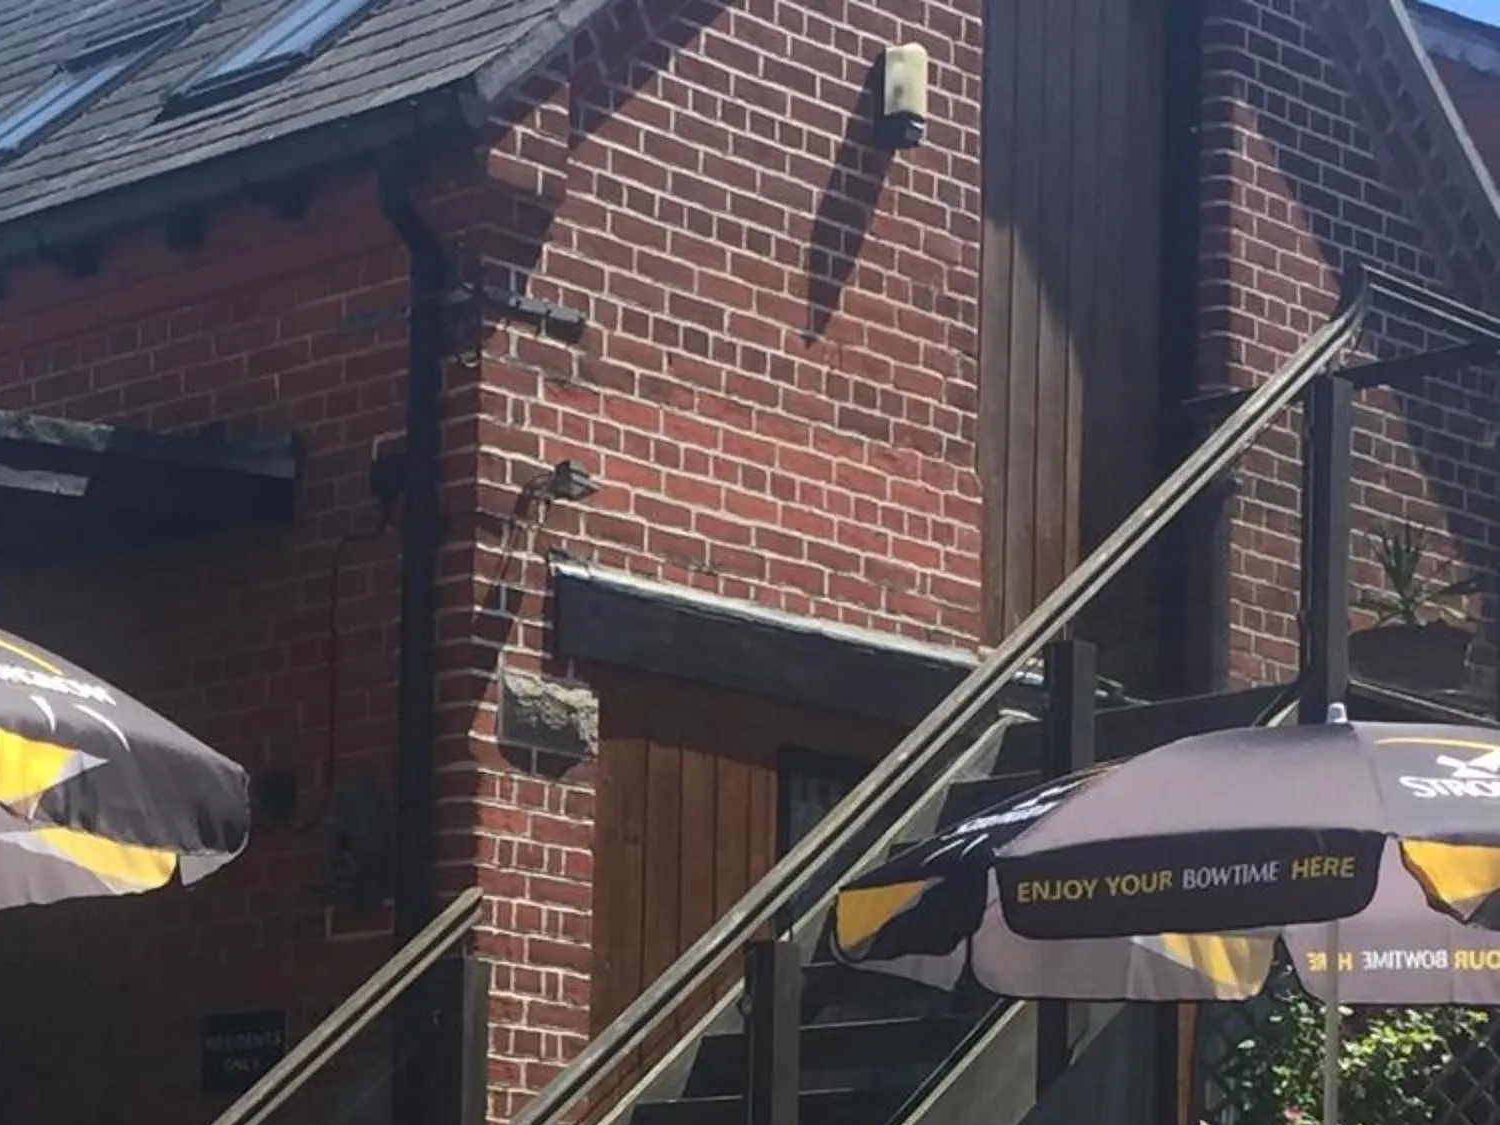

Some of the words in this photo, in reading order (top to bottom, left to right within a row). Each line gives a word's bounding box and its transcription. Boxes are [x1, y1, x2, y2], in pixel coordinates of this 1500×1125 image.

[1016, 878, 1099, 903] ENJOY
[1105, 870, 1173, 896] YOUR
[1182, 861, 1280, 890] BOWTIME
[1291, 856, 1356, 881] HERE
